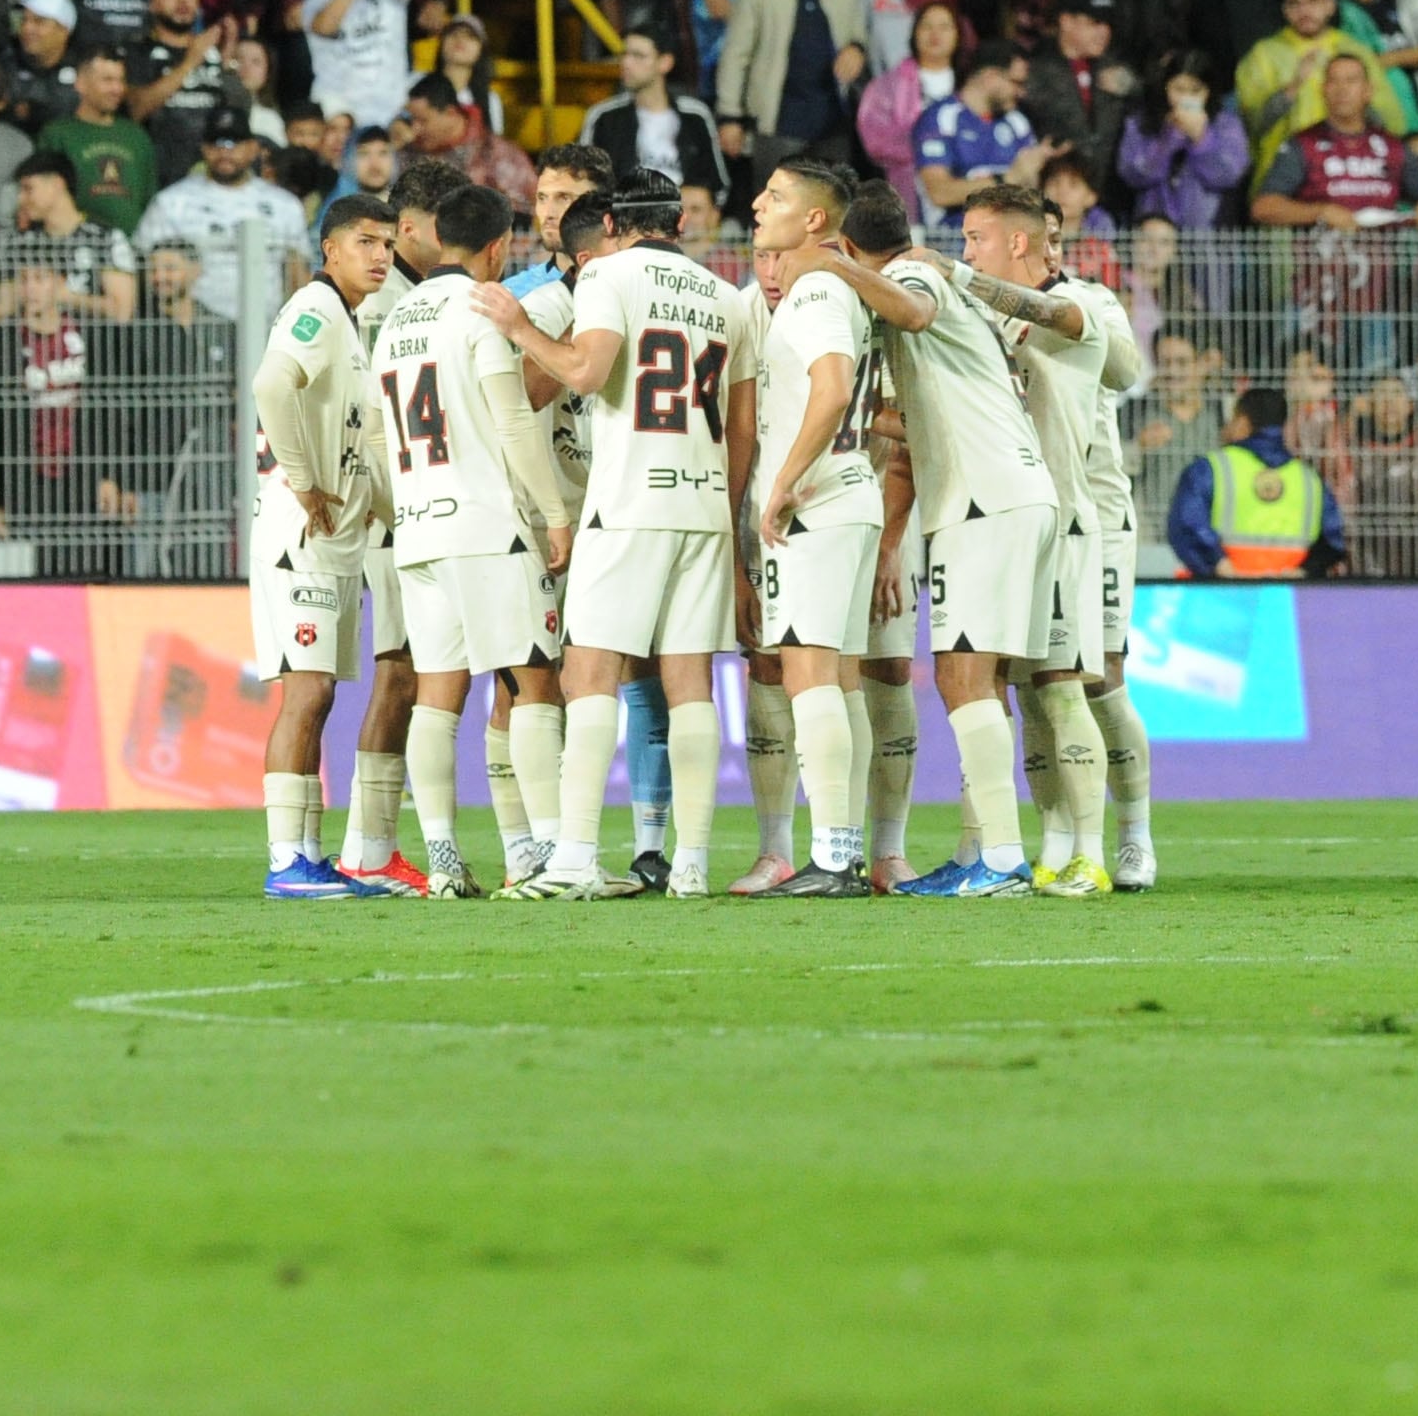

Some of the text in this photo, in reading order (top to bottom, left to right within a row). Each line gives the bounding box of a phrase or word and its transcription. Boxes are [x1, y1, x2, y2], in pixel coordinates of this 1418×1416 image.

[645, 264, 720, 301] Tropical
[793, 290, 829, 311] Mobil
[389, 336, 429, 361] A.BRAN
[634, 328, 728, 445] 24
[380, 362, 451, 475] 14
[393, 497, 458, 528] BYD
[297, 588, 338, 609] ABUS
[765, 558, 779, 600] 8
[931, 563, 946, 605] 5
[1103, 567, 1120, 608] 2
[1052, 580, 1063, 620] 1
